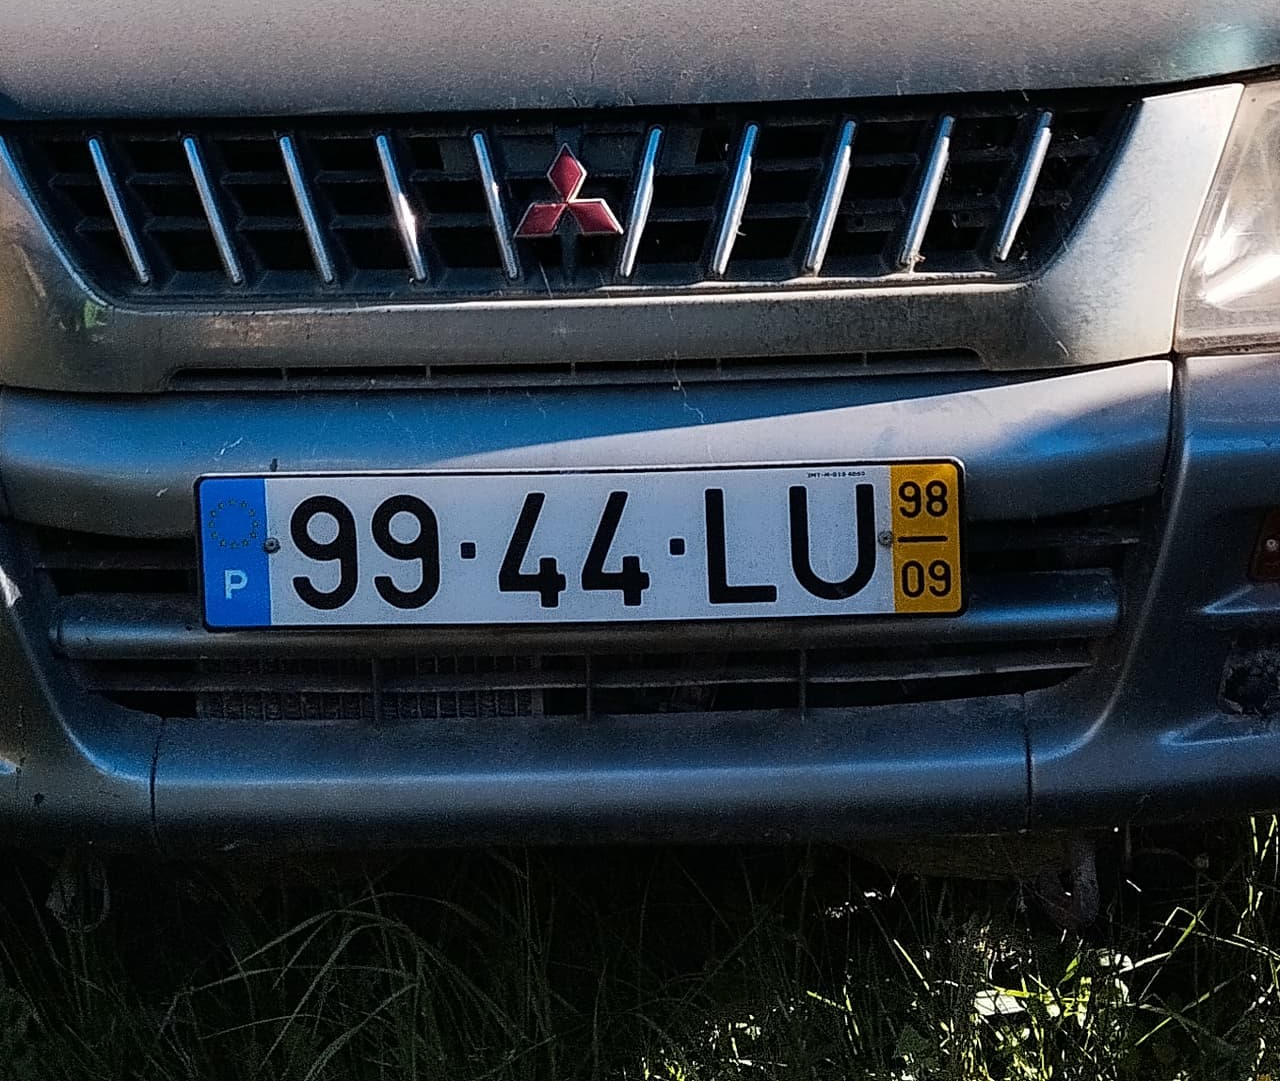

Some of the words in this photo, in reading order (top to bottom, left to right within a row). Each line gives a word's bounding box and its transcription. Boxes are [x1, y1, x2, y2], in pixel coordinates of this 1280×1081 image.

[898, 480, 948, 518] 98
[224, 570, 248, 600] P
[901, 559, 951, 598] 09
